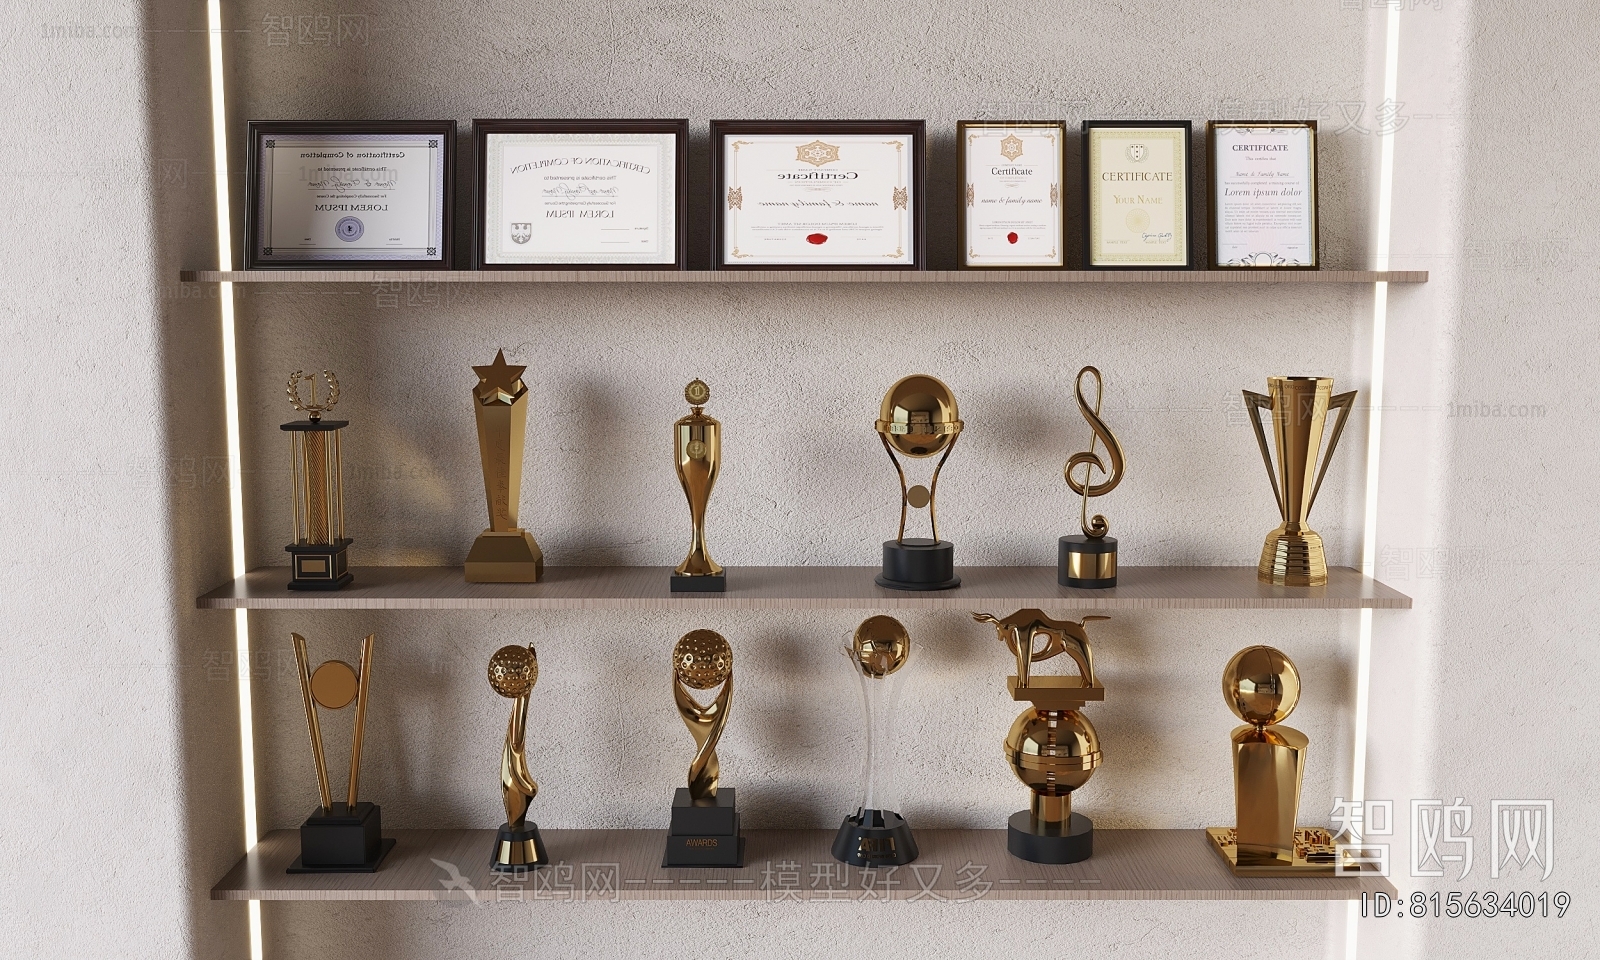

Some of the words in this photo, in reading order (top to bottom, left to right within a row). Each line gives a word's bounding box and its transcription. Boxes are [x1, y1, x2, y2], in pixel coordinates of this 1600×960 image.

[992, 167, 1033, 175] Certificate
[1102, 172, 1173, 182] CERTIFICATE
[1224, 188, 1250, 196] Lorem
[1253, 188, 1278, 198] ipsum
[1280, 188, 1302, 196] dolor
[1005, 196, 1026, 205] family
[686, 838, 718, 847] AWARDS
